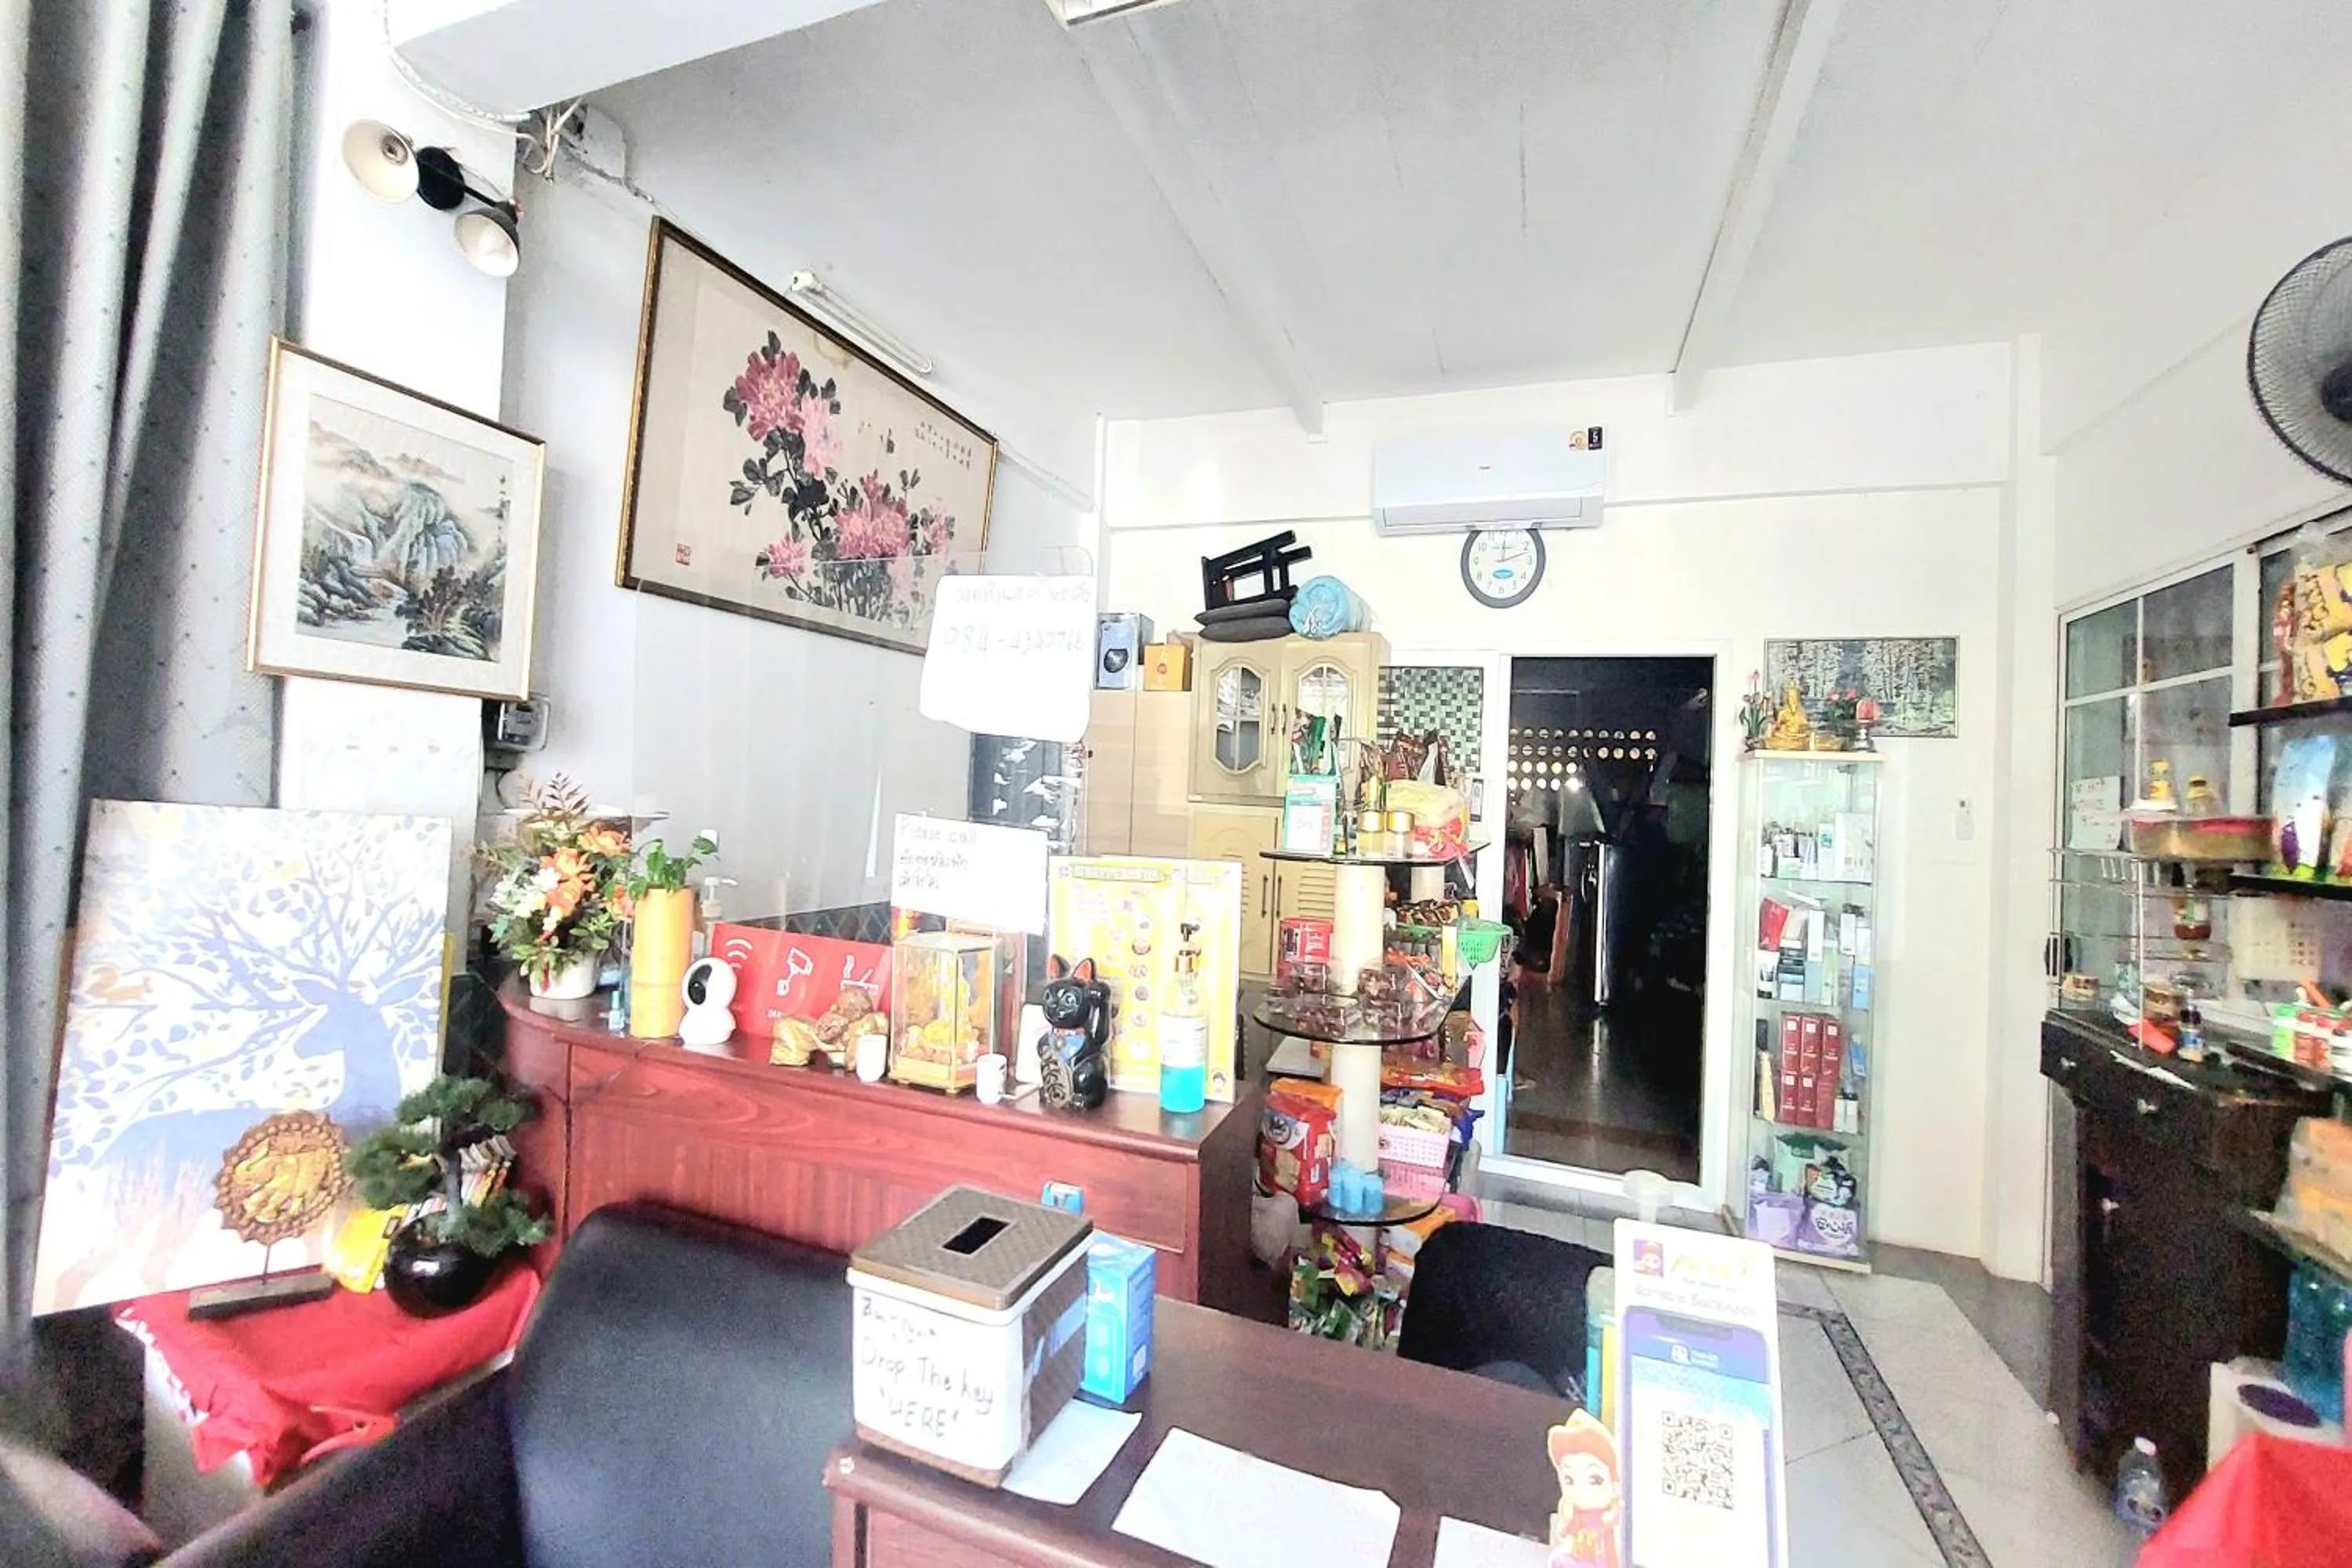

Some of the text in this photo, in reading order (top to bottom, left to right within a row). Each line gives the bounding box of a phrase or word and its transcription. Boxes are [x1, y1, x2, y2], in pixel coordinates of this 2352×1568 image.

[901, 816, 977, 844] Please call
[861, 1336, 994, 1416] Drop The key
